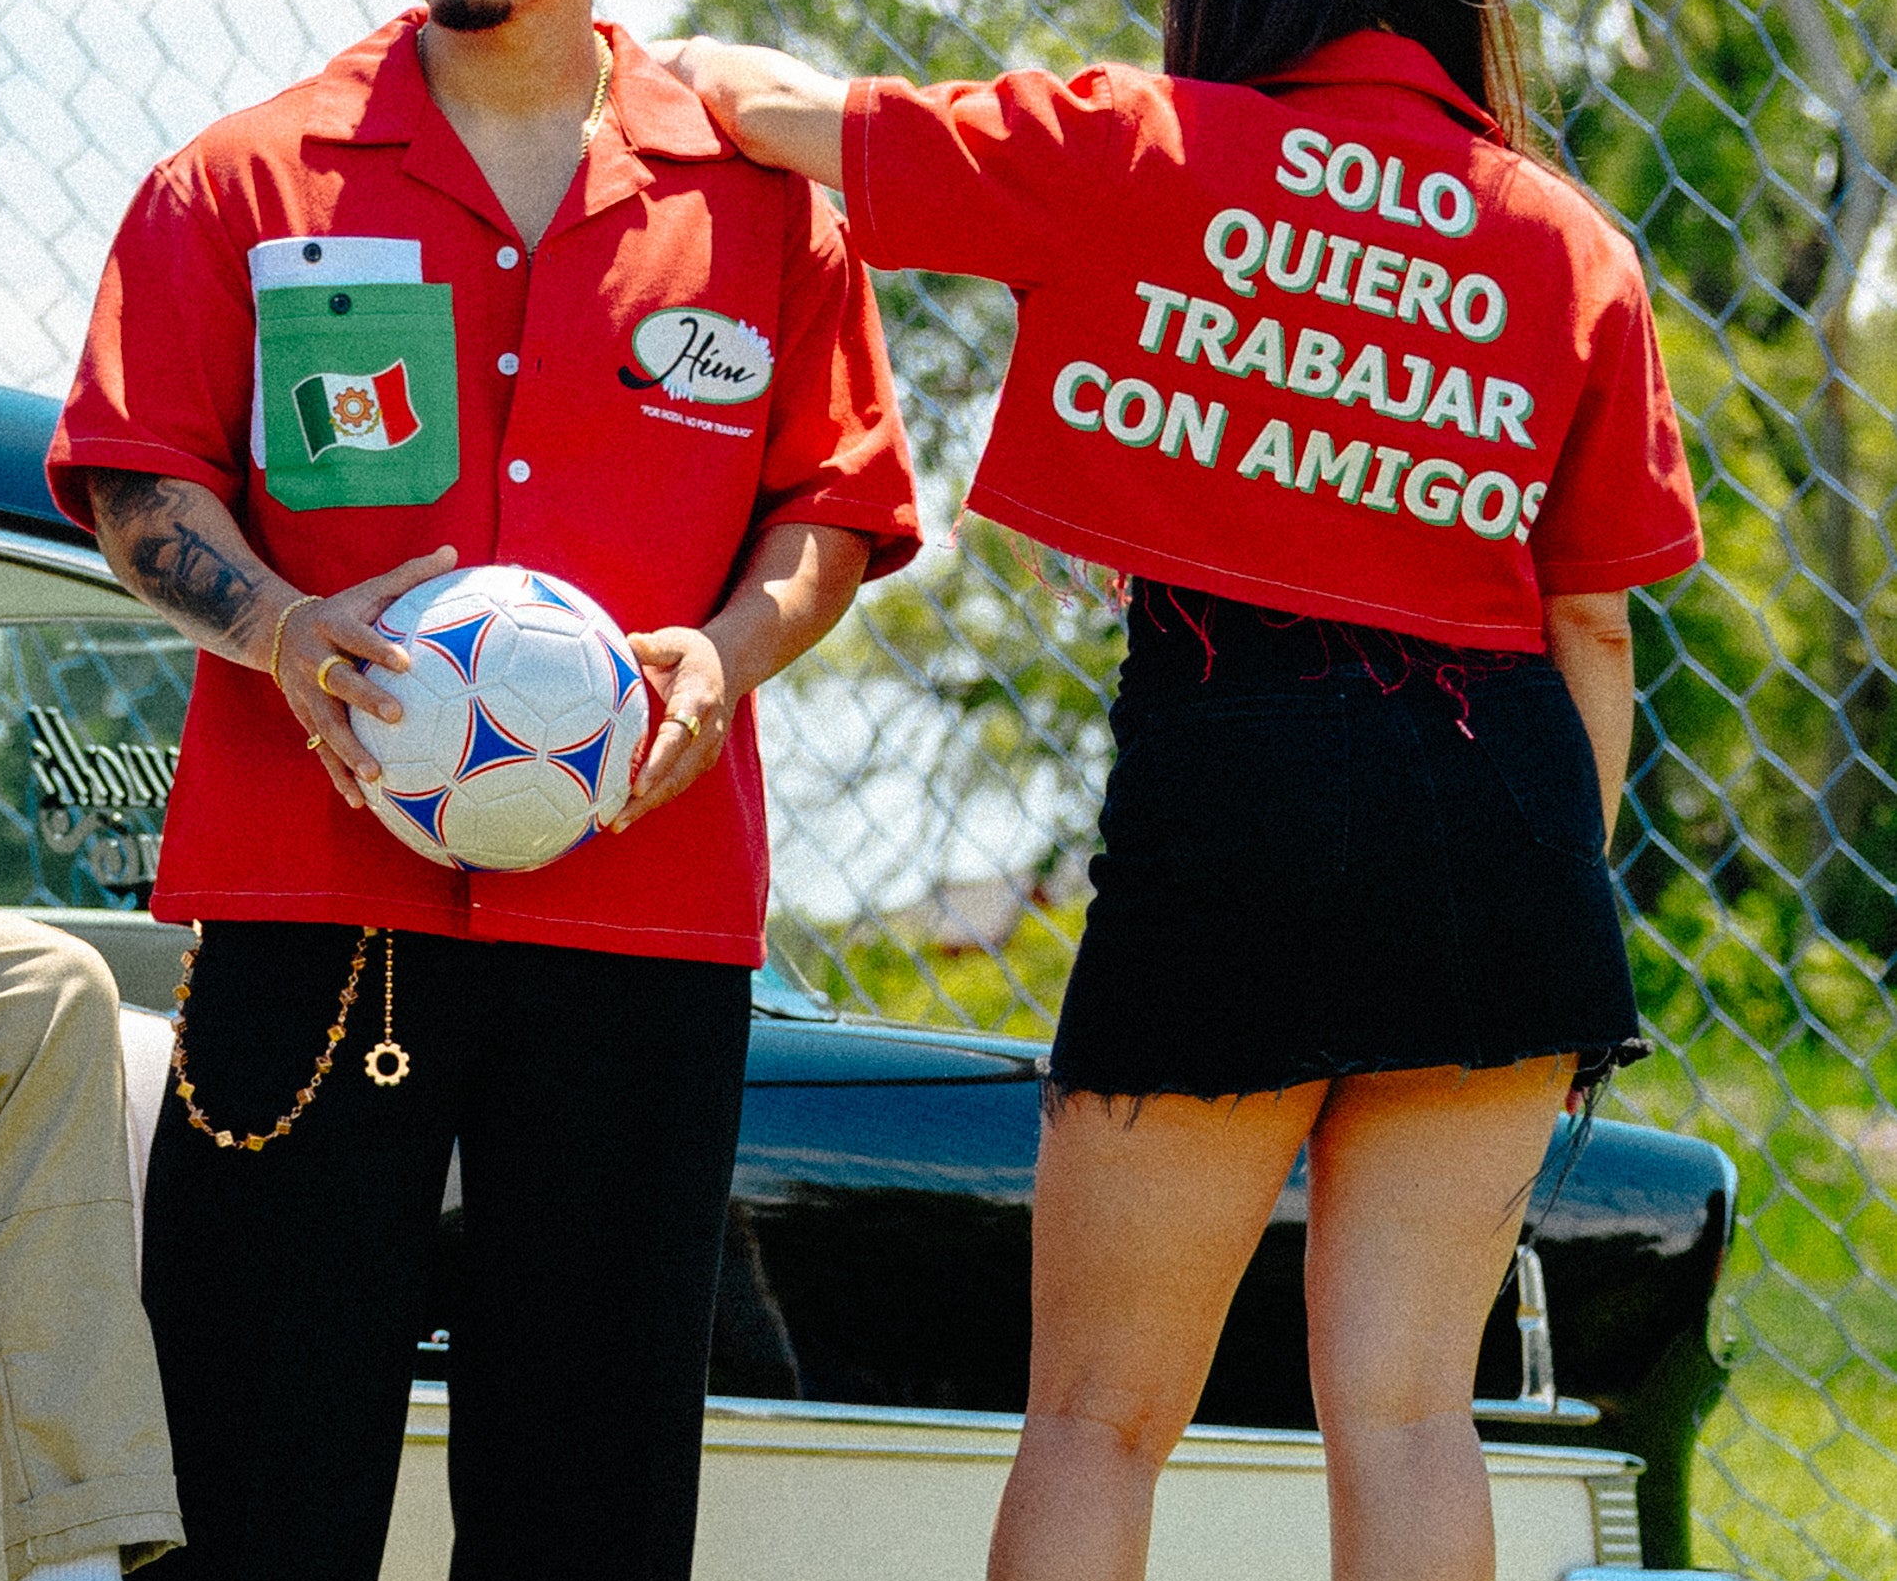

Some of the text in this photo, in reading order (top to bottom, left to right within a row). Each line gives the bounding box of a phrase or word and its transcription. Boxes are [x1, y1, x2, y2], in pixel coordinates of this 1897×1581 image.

[1276, 128, 1477, 239] SOLO
[1204, 208, 1507, 343] QUIERO
[1052, 361, 1229, 469] CON
[1135, 281, 1536, 450] TRABAJAR
